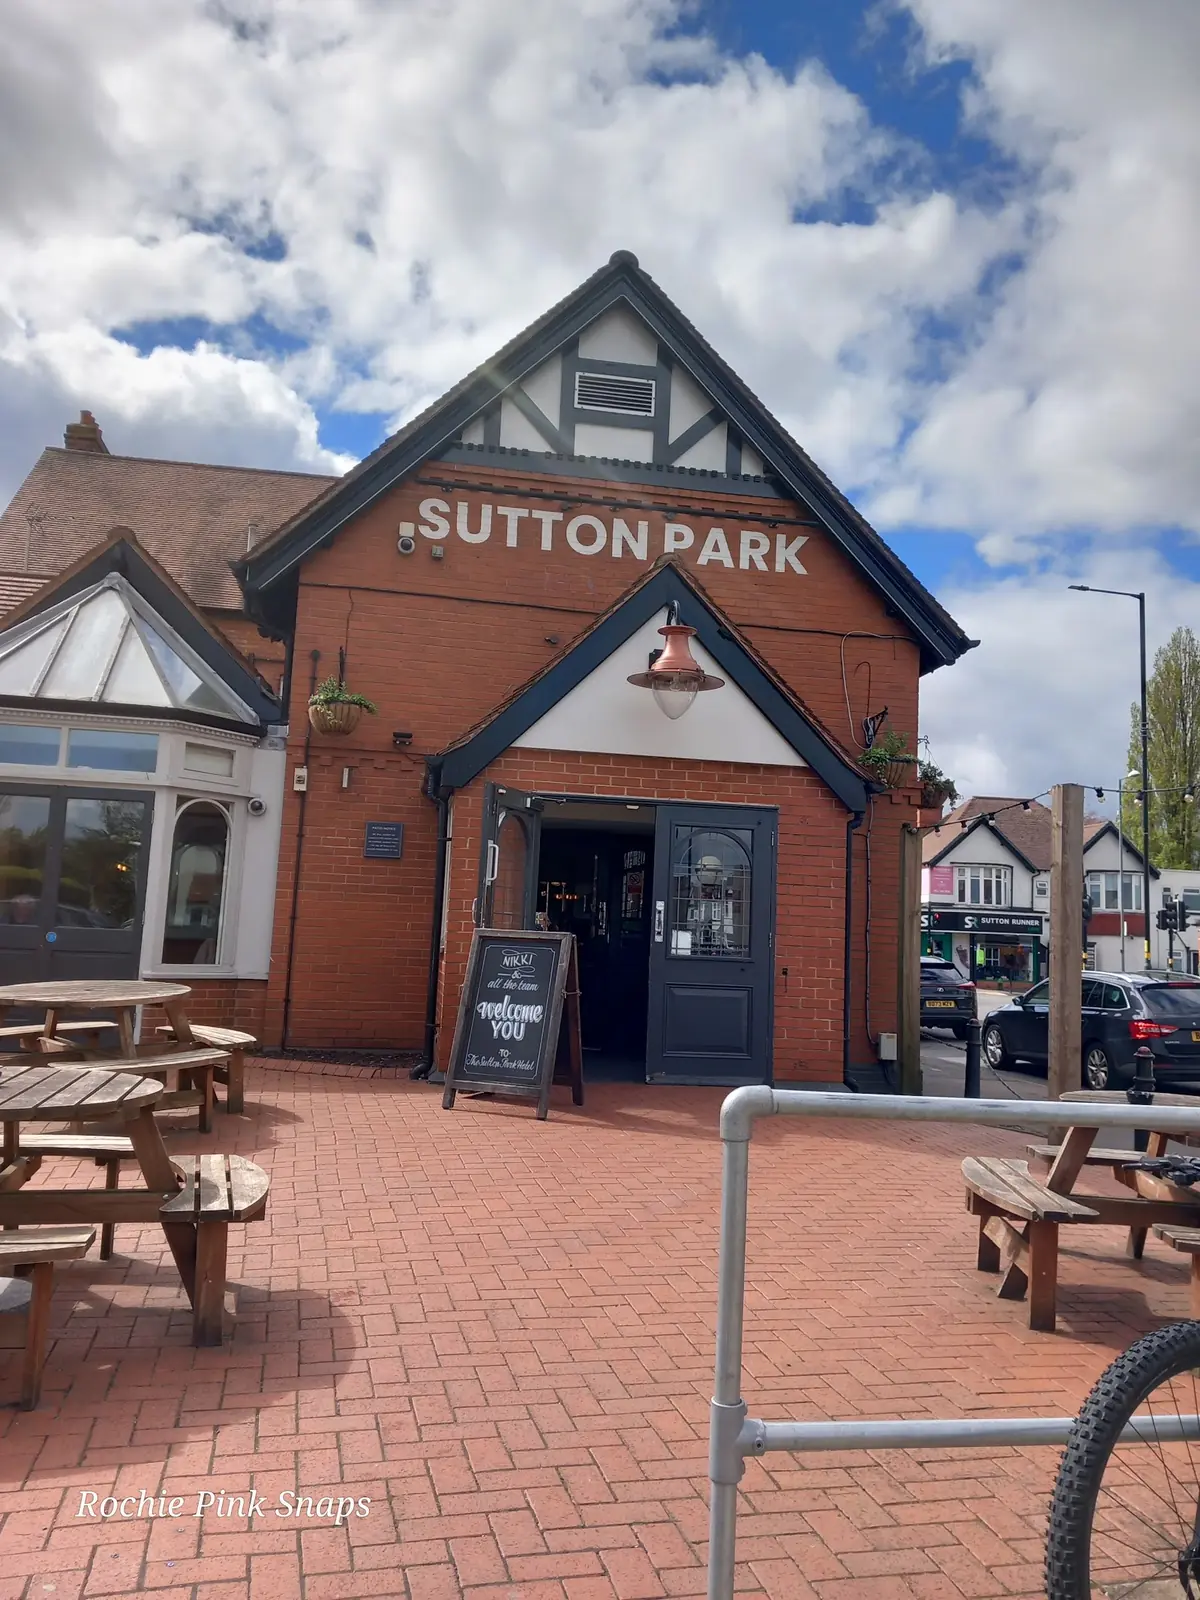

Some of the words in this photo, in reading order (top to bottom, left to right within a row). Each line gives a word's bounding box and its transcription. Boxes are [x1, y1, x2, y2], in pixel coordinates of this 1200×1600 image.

[417, 498, 649, 560] SUTTON
[663, 522, 810, 575] PARK
[1011, 918, 1040, 926] RUNNER
[502, 954, 533, 967] NIKKI
[511, 970, 522, 979] &
[487, 978, 503, 989] all
[502, 979, 518, 990] the
[518, 980, 539, 991] team
[476, 995, 544, 1023] welcome
[491, 1020, 526, 1041] YOU
[480, 1056, 500, 1068] Sutton
[500, 1057, 517, 1069] Park
[517, 1060, 535, 1071] Hotel
